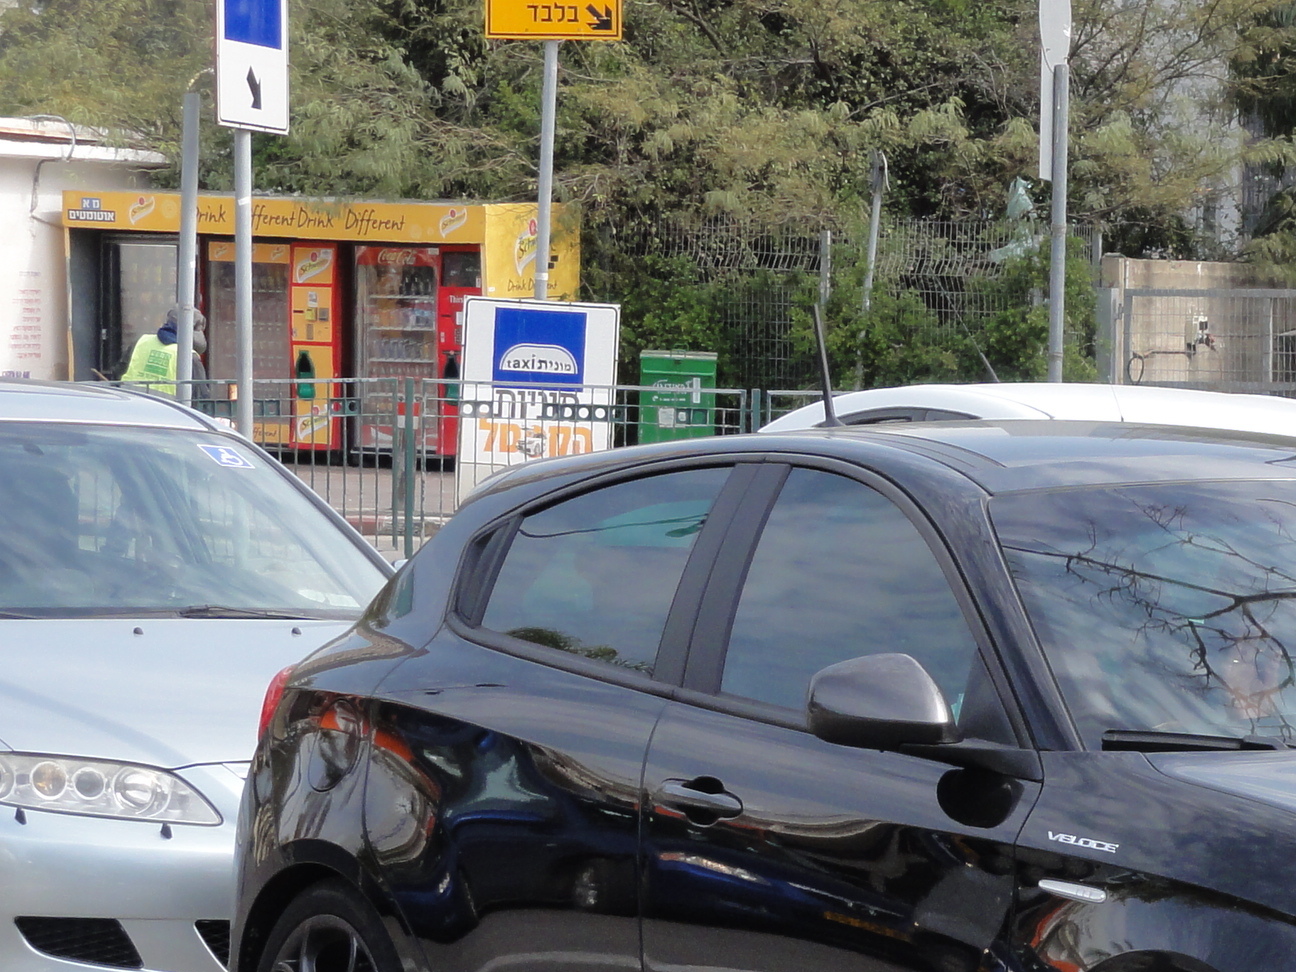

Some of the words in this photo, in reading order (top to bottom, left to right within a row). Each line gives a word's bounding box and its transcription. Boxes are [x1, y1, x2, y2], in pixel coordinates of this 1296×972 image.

[527, 2, 580, 23] בלבד
[68, 210, 115, 222] אוטומטים
[251, 204, 296, 231] fferent
[297, 206, 334, 229] Drink
[345, 208, 406, 236] Different
[507, 279, 527, 292] Drink
[506, 353, 535, 370] taxi
[537, 358, 572, 372] מונית
[1047, 830, 1120, 854] VELOCE
